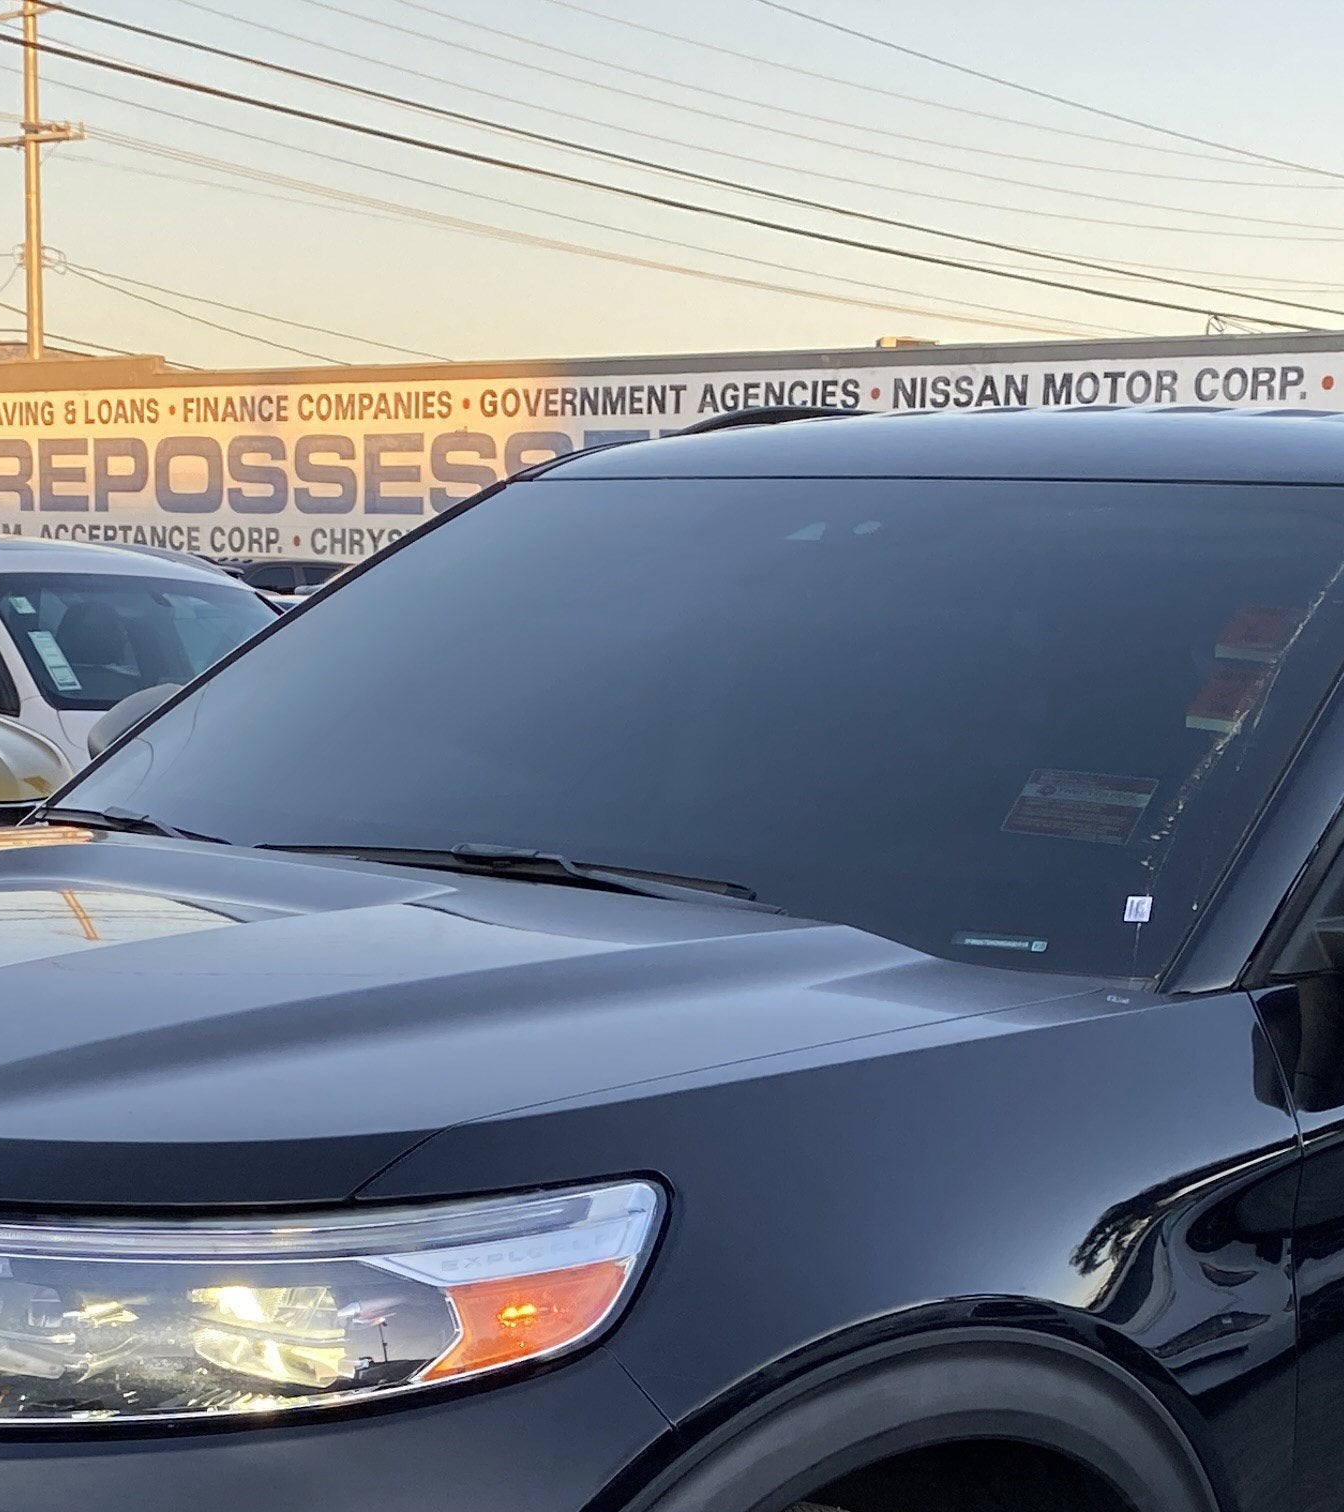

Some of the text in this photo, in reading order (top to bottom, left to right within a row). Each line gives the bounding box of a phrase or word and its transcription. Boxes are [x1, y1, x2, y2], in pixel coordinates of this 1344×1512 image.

[64, 400, 79, 425] &
[84, 397, 159, 425] LOANS
[183, 395, 289, 423] FINANCE
[298, 390, 453, 421] COMPANIES
[480, 384, 687, 418] GOVERNMENT
[697, 378, 861, 414] AGENCIES
[892, 373, 1029, 409] NISSAN
[1042, 369, 1177, 406] MOTOR
[1193, 366, 1307, 402] CORP.
[210, 526, 282, 553] CORP.
[310, 527, 412, 556] CHRYS
